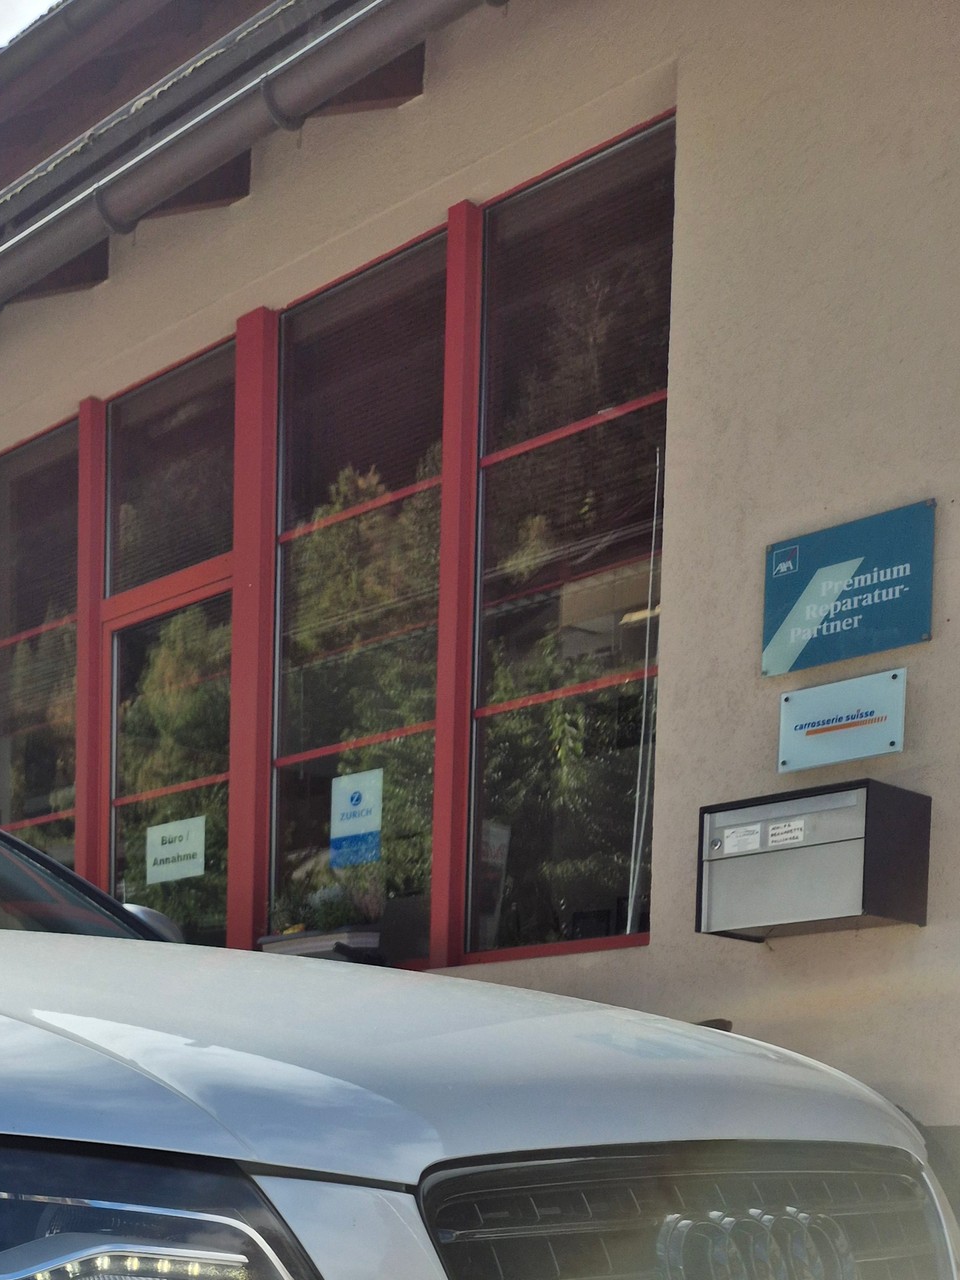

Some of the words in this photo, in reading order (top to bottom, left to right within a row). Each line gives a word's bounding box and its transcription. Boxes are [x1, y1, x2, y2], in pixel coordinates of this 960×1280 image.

[821, 562, 911, 596] Premium
[805, 583, 910, 620] Reparatur-
[790, 614, 863, 643] Partner
[794, 715, 844, 731] carrosserie
[845, 708, 875, 722] suisse
[340, 807, 373, 821] ZURICH
[161, 833, 184, 846] Büro
[152, 852, 198, 867] Annahme
